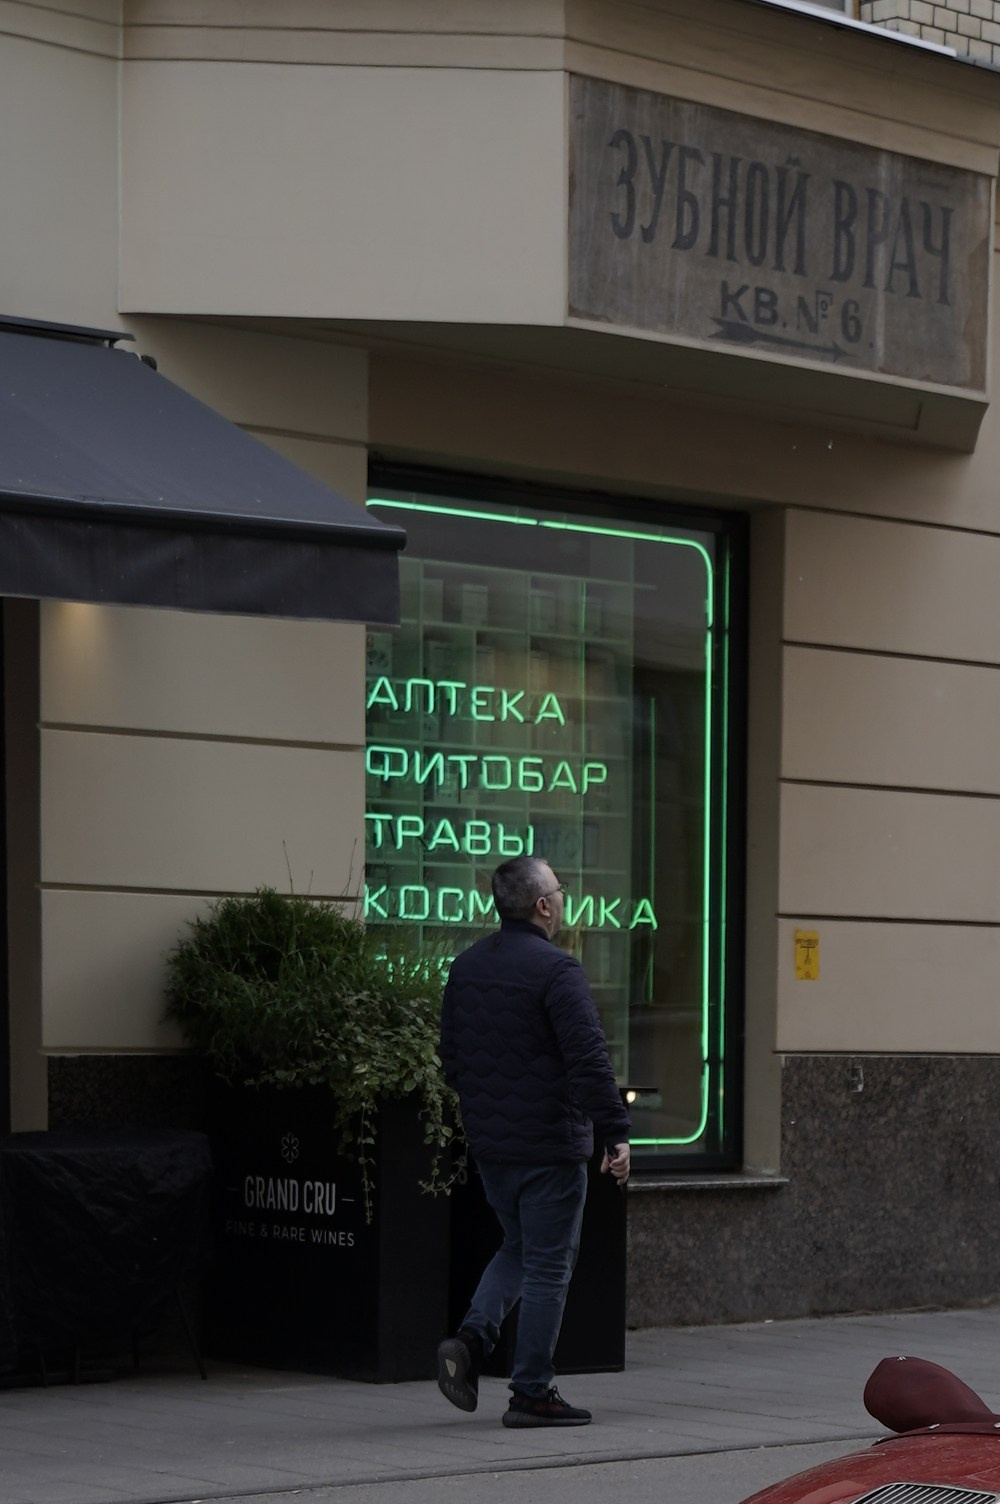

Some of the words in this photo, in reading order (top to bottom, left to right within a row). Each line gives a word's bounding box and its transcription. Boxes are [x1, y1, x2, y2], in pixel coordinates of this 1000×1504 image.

[608, 129, 811, 278] ЗУБНОЙ
[829, 179, 955, 306] ВРАЧ
[367, 676, 566, 726] АПТЕКА
[365, 745, 608, 796] ФИТОБАР
[364, 812, 535, 857] ТРАВЫ
[363, 884, 659, 931] КОСМИКА
[244, 1175, 300, 1212] GRAND
[303, 1180, 337, 1216] CRU
[273, 1224, 307, 1242] RARE
[311, 1228, 356, 1247] WINES
